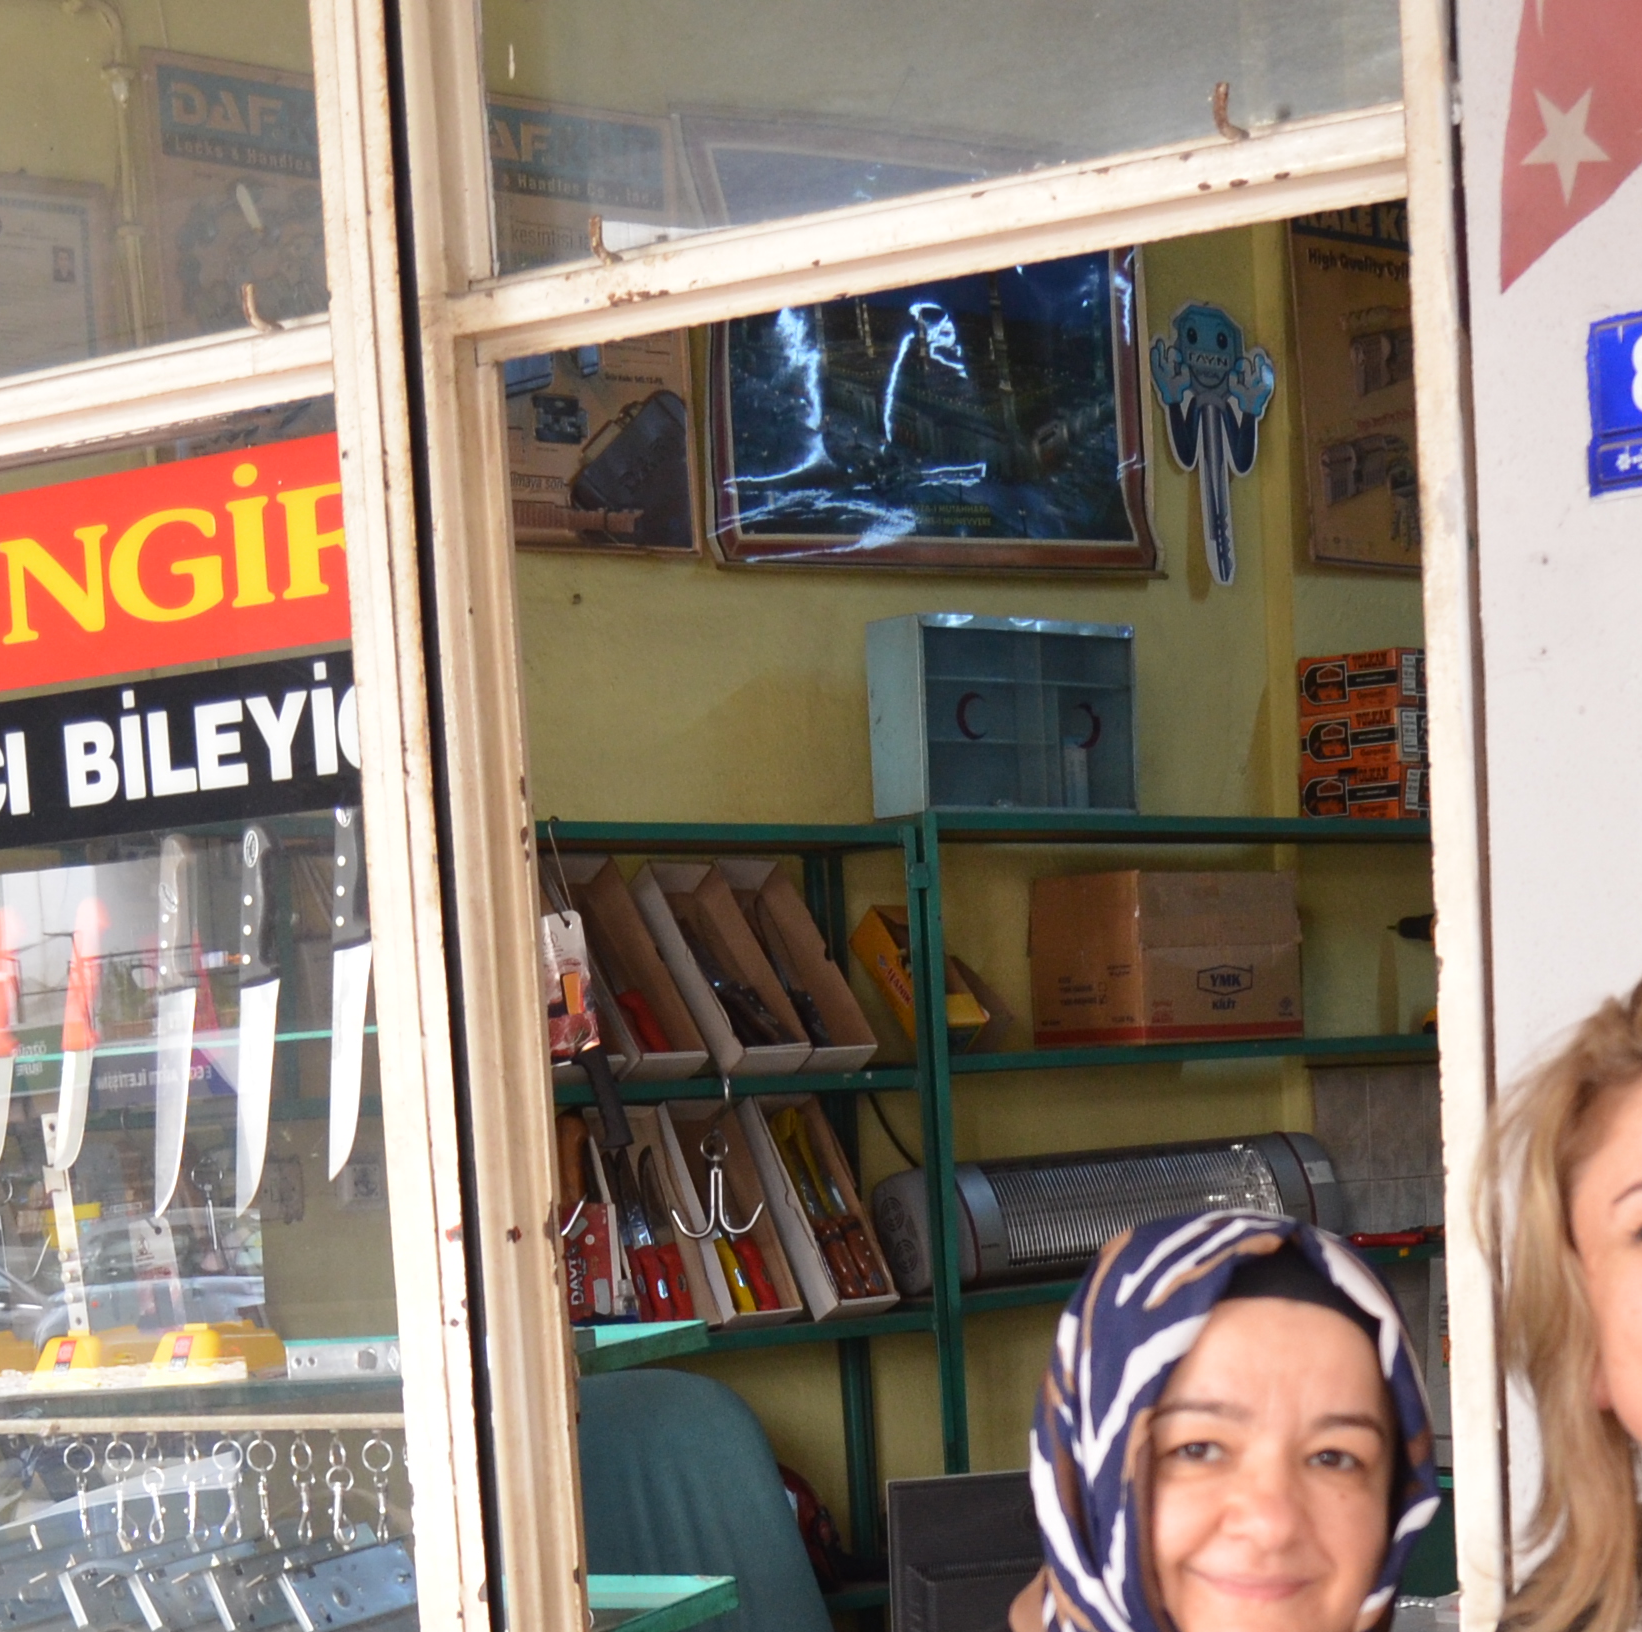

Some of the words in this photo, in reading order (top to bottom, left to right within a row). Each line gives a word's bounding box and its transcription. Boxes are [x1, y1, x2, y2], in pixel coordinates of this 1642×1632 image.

[171, 80, 283, 138] DAF
[174, 135, 224, 159] Locks
[247, 148, 314, 172] Handles
[1209, 974, 1242, 988] YMK
